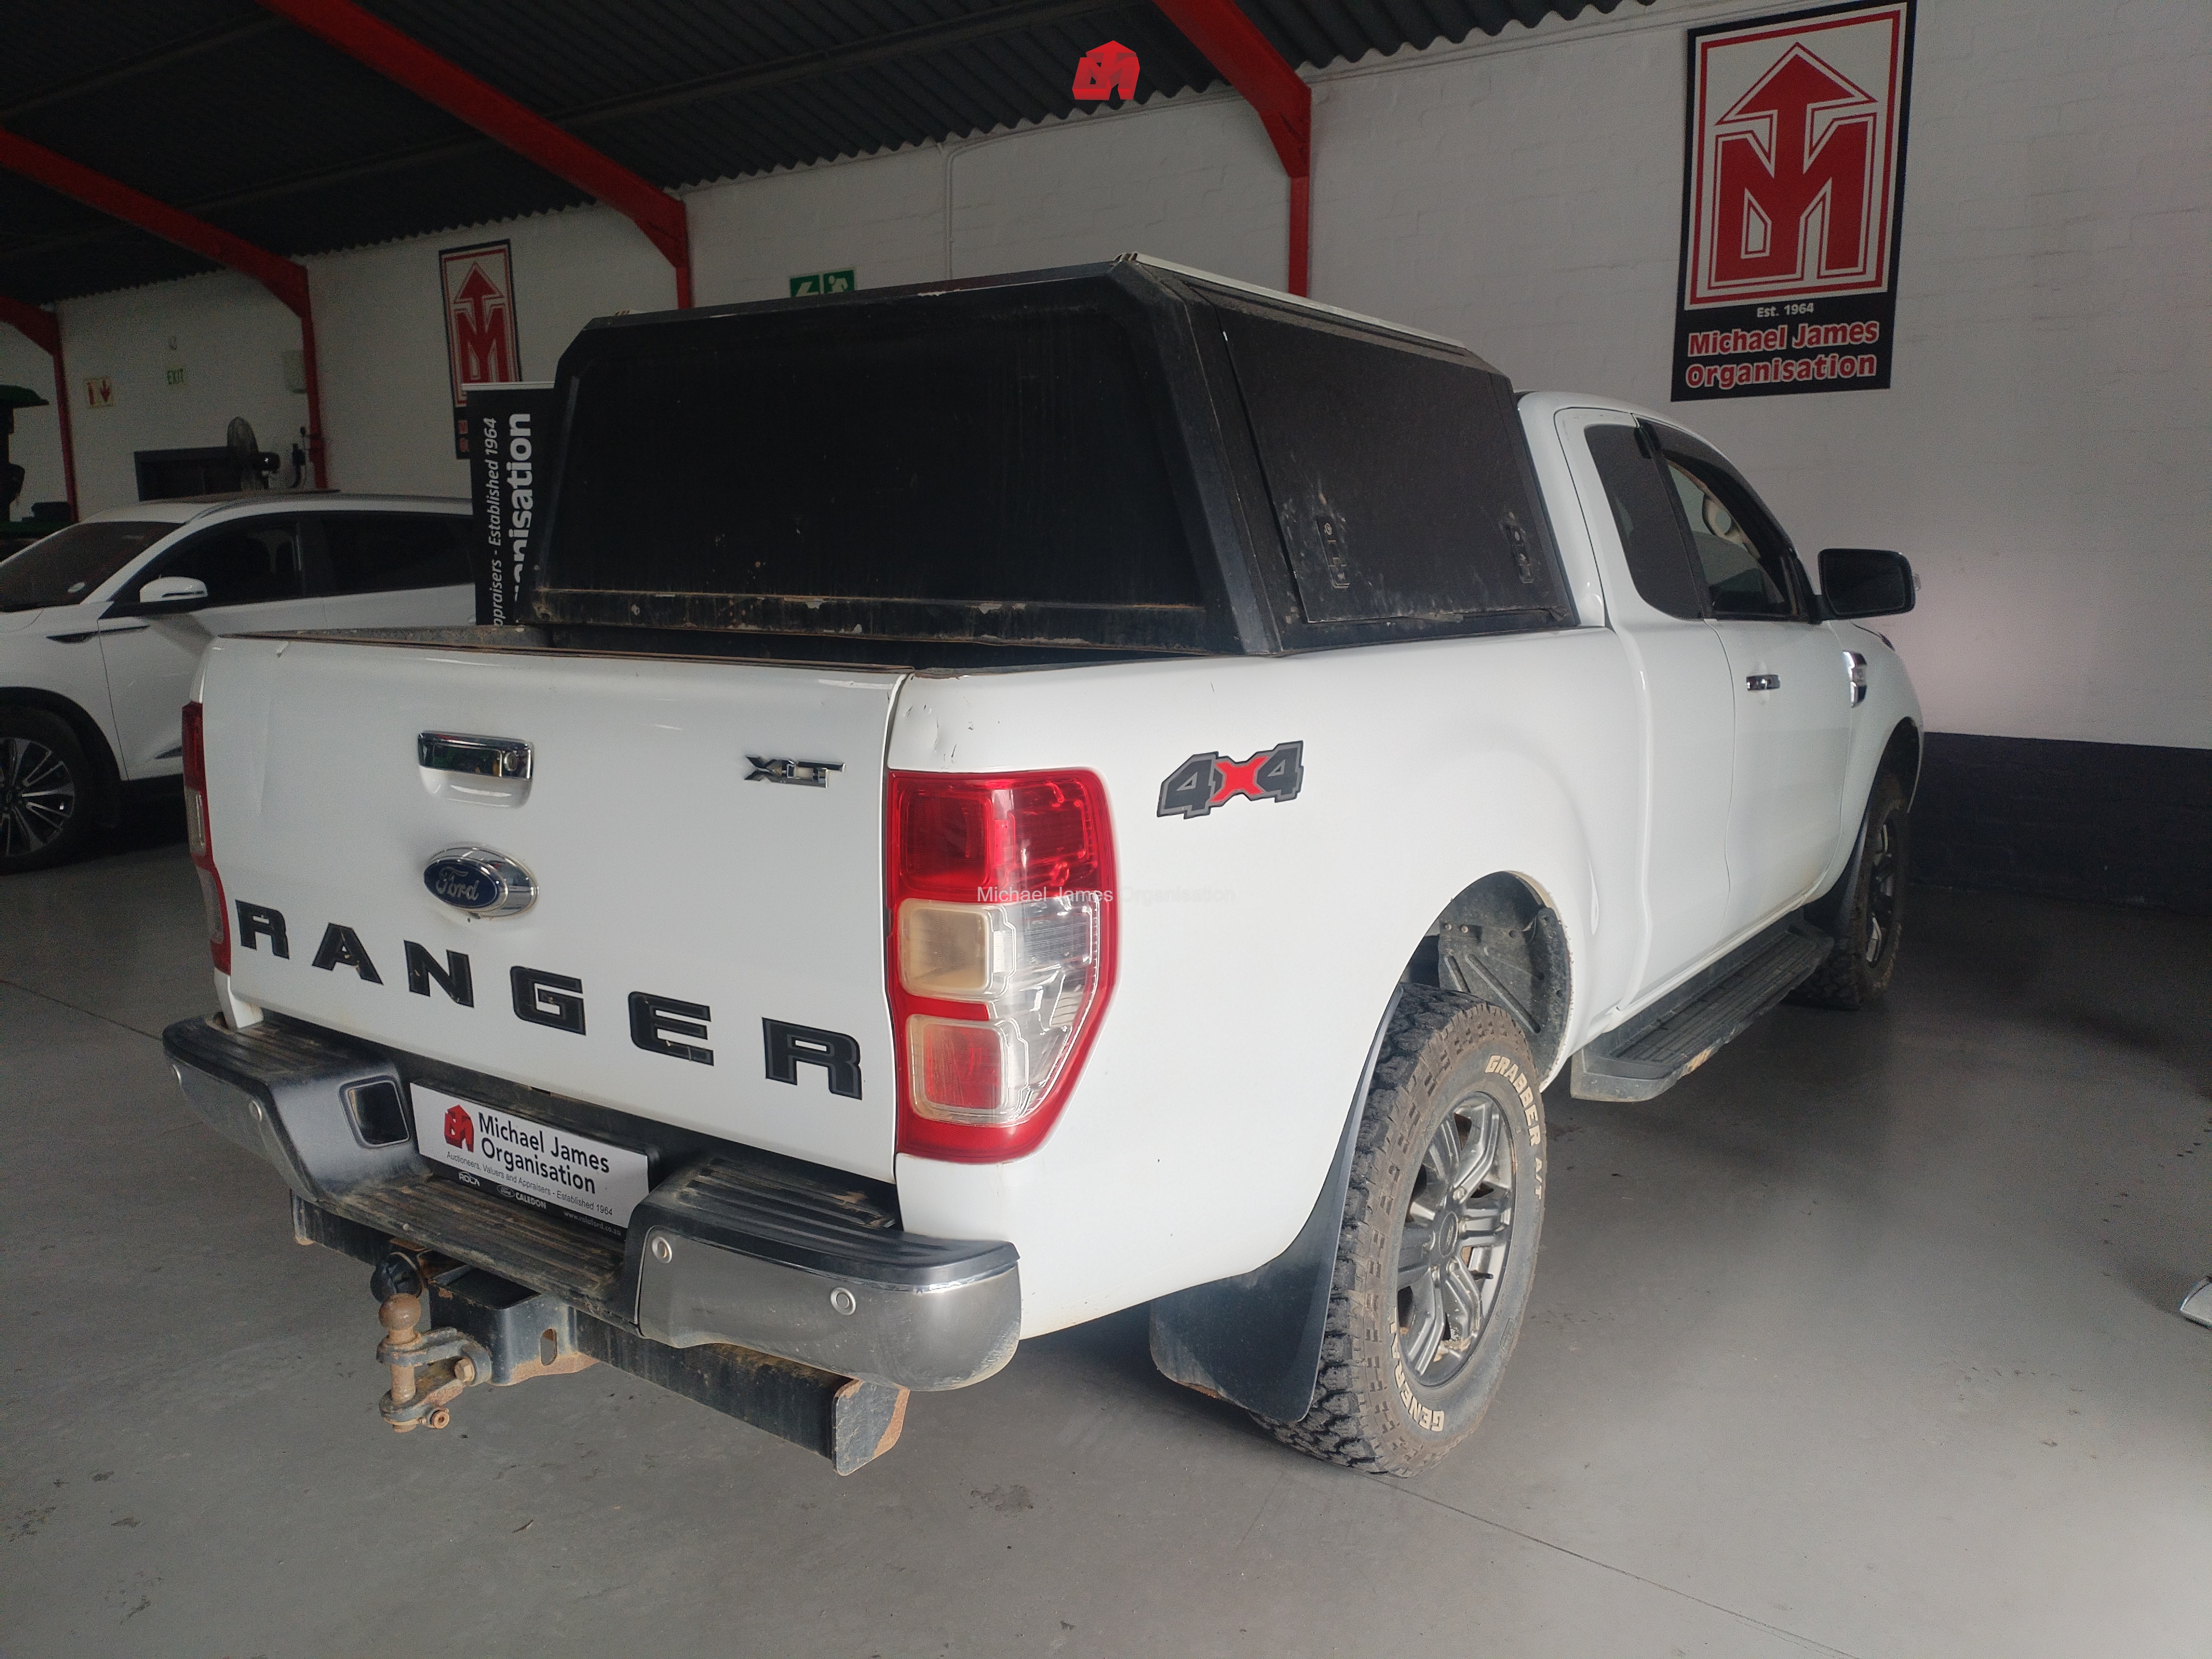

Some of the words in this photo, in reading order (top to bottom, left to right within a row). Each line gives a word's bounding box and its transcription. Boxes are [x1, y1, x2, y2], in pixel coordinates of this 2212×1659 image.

[1757, 307, 1779, 318] Est.
[1784, 302, 1814, 315] 1964
[1688, 325, 1788, 356] Michael
[1792, 320, 1879, 349] James
[1686, 354, 1877, 389] Organisation
[483, 417, 498, 455] 1964
[485, 460, 502, 546] Established
[489, 558, 505, 625] praisers
[435, 866, 480, 901] Ford
[234, 899, 863, 1101] RANGER
[1485, 1054, 1541, 1147] GRABBER
[478, 1111, 544, 1153] Michael
[551, 1136, 610, 1174] James
[482, 1137, 596, 1194] Organisation
[483, 1164, 505, 1179] Valuers
[506, 1174, 517, 1183] and
[518, 1177, 551, 1195] Appraisers
[557, 1190, 594, 1210] Established
[596, 1204, 613, 1216] 1964
[516, 1192, 547, 1209] CALEDON
[1390, 1306, 1445, 1432] GENERAL
